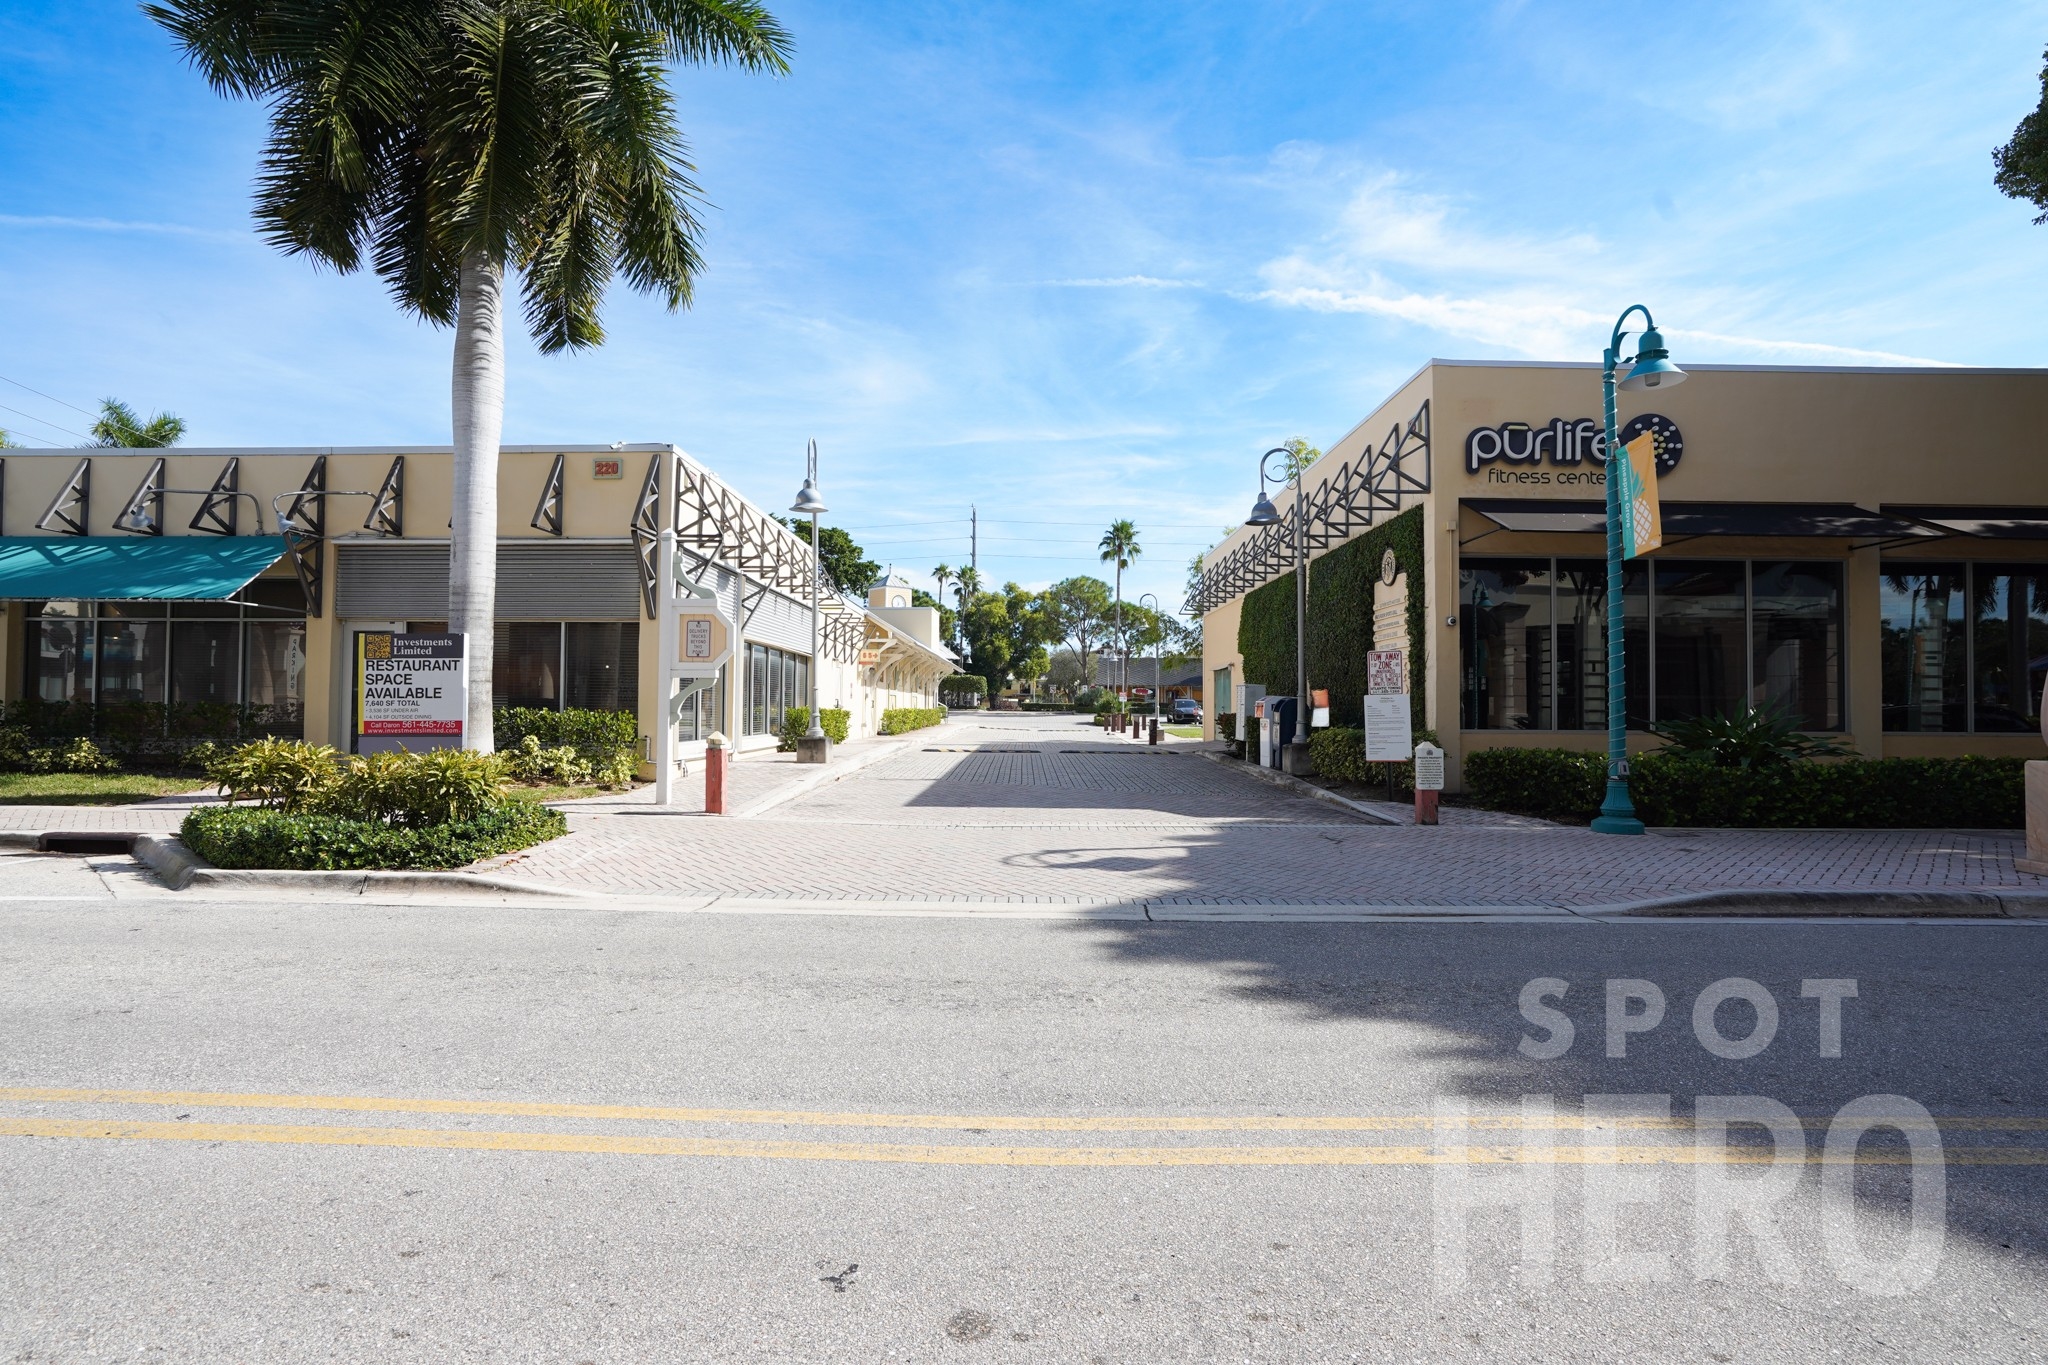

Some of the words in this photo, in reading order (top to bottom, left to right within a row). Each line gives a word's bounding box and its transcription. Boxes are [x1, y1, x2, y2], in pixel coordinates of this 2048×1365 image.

[596, 462, 618, 474] 220
[1488, 468, 1550, 484] fitness
[1556, 470, 1607, 484] cente
[1622, 458, 1630, 500] Pineapple
[394, 638, 452, 646] Investments
[394, 647, 432, 655] Limited
[366, 660, 460, 671] RESTAURANT
[1378, 661, 1392, 669] ZONE
[366, 674, 412, 685] SPACE
[365, 688, 442, 699] AVAILABLE
